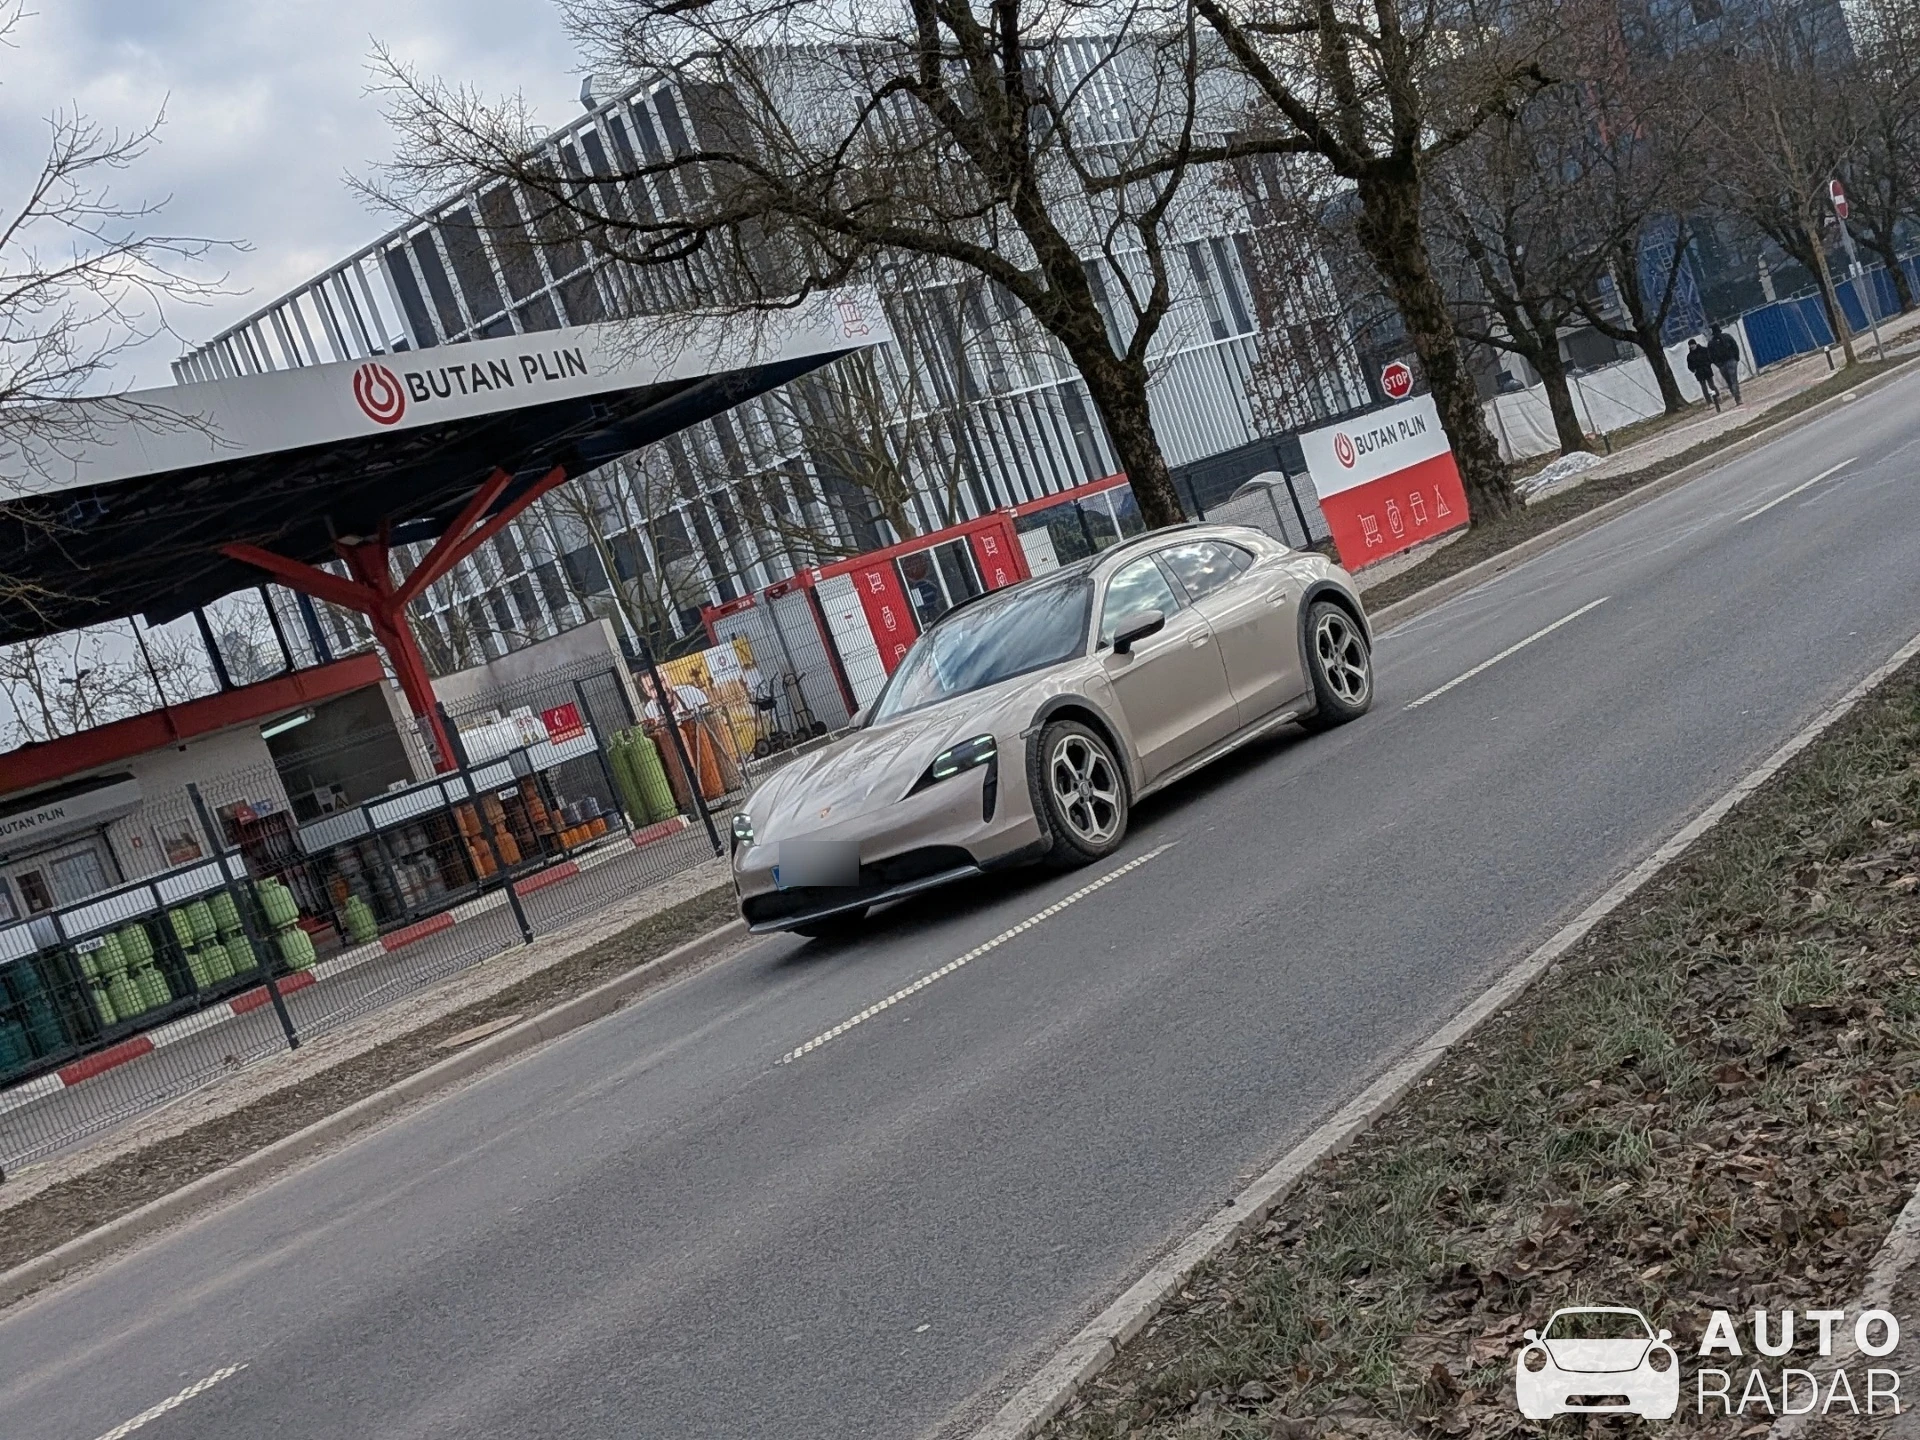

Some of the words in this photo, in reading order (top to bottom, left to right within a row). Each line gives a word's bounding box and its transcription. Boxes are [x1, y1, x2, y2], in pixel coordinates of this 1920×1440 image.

[404, 358, 515, 403] BUTAN
[518, 347, 588, 384] PLIN
[1384, 371, 1408, 391] STOP
[1353, 424, 1398, 456] BUTAN
[1397, 414, 1427, 440] PLIN
[37, 807, 65, 824] PLIN
